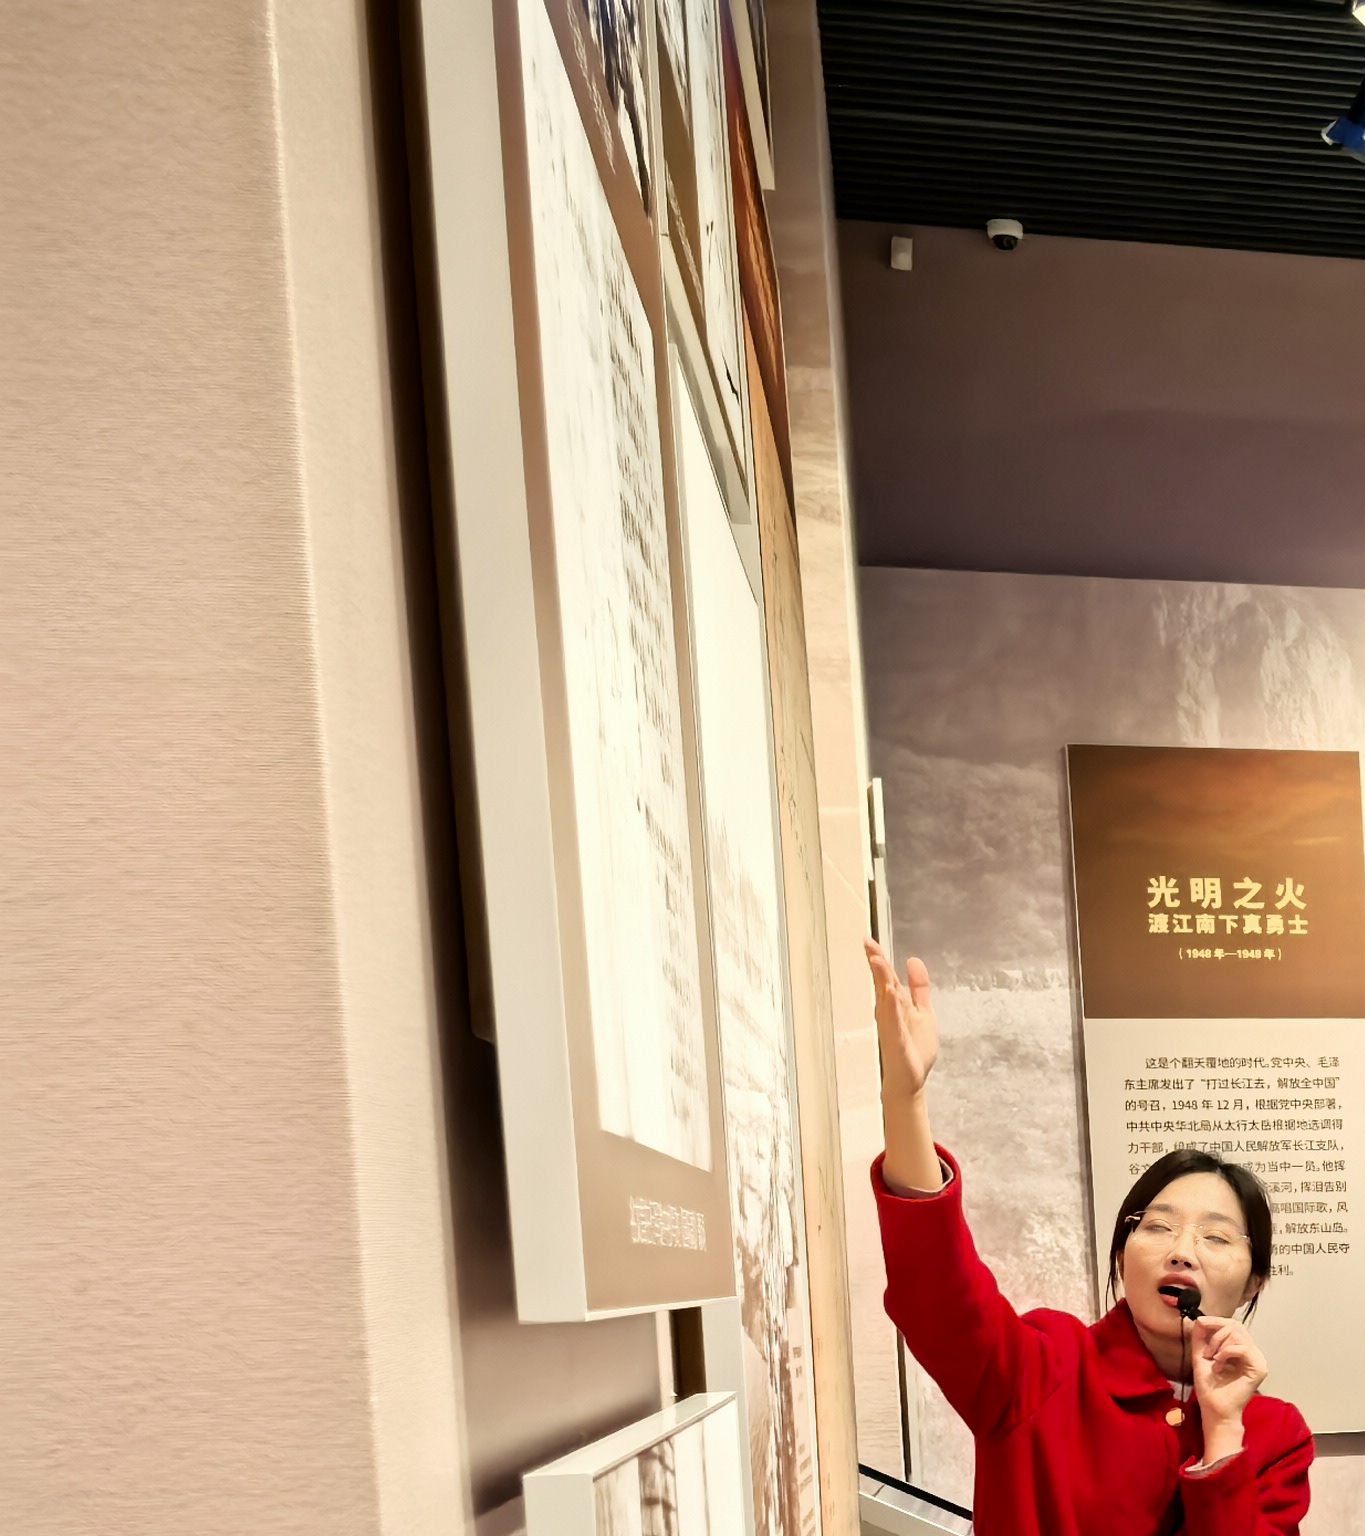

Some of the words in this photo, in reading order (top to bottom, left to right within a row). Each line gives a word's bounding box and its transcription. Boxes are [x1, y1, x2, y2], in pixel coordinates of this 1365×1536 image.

[1147, 875, 1307, 910] 光明之火
[1148, 913, 1309, 935] 渡江南下真勇士
